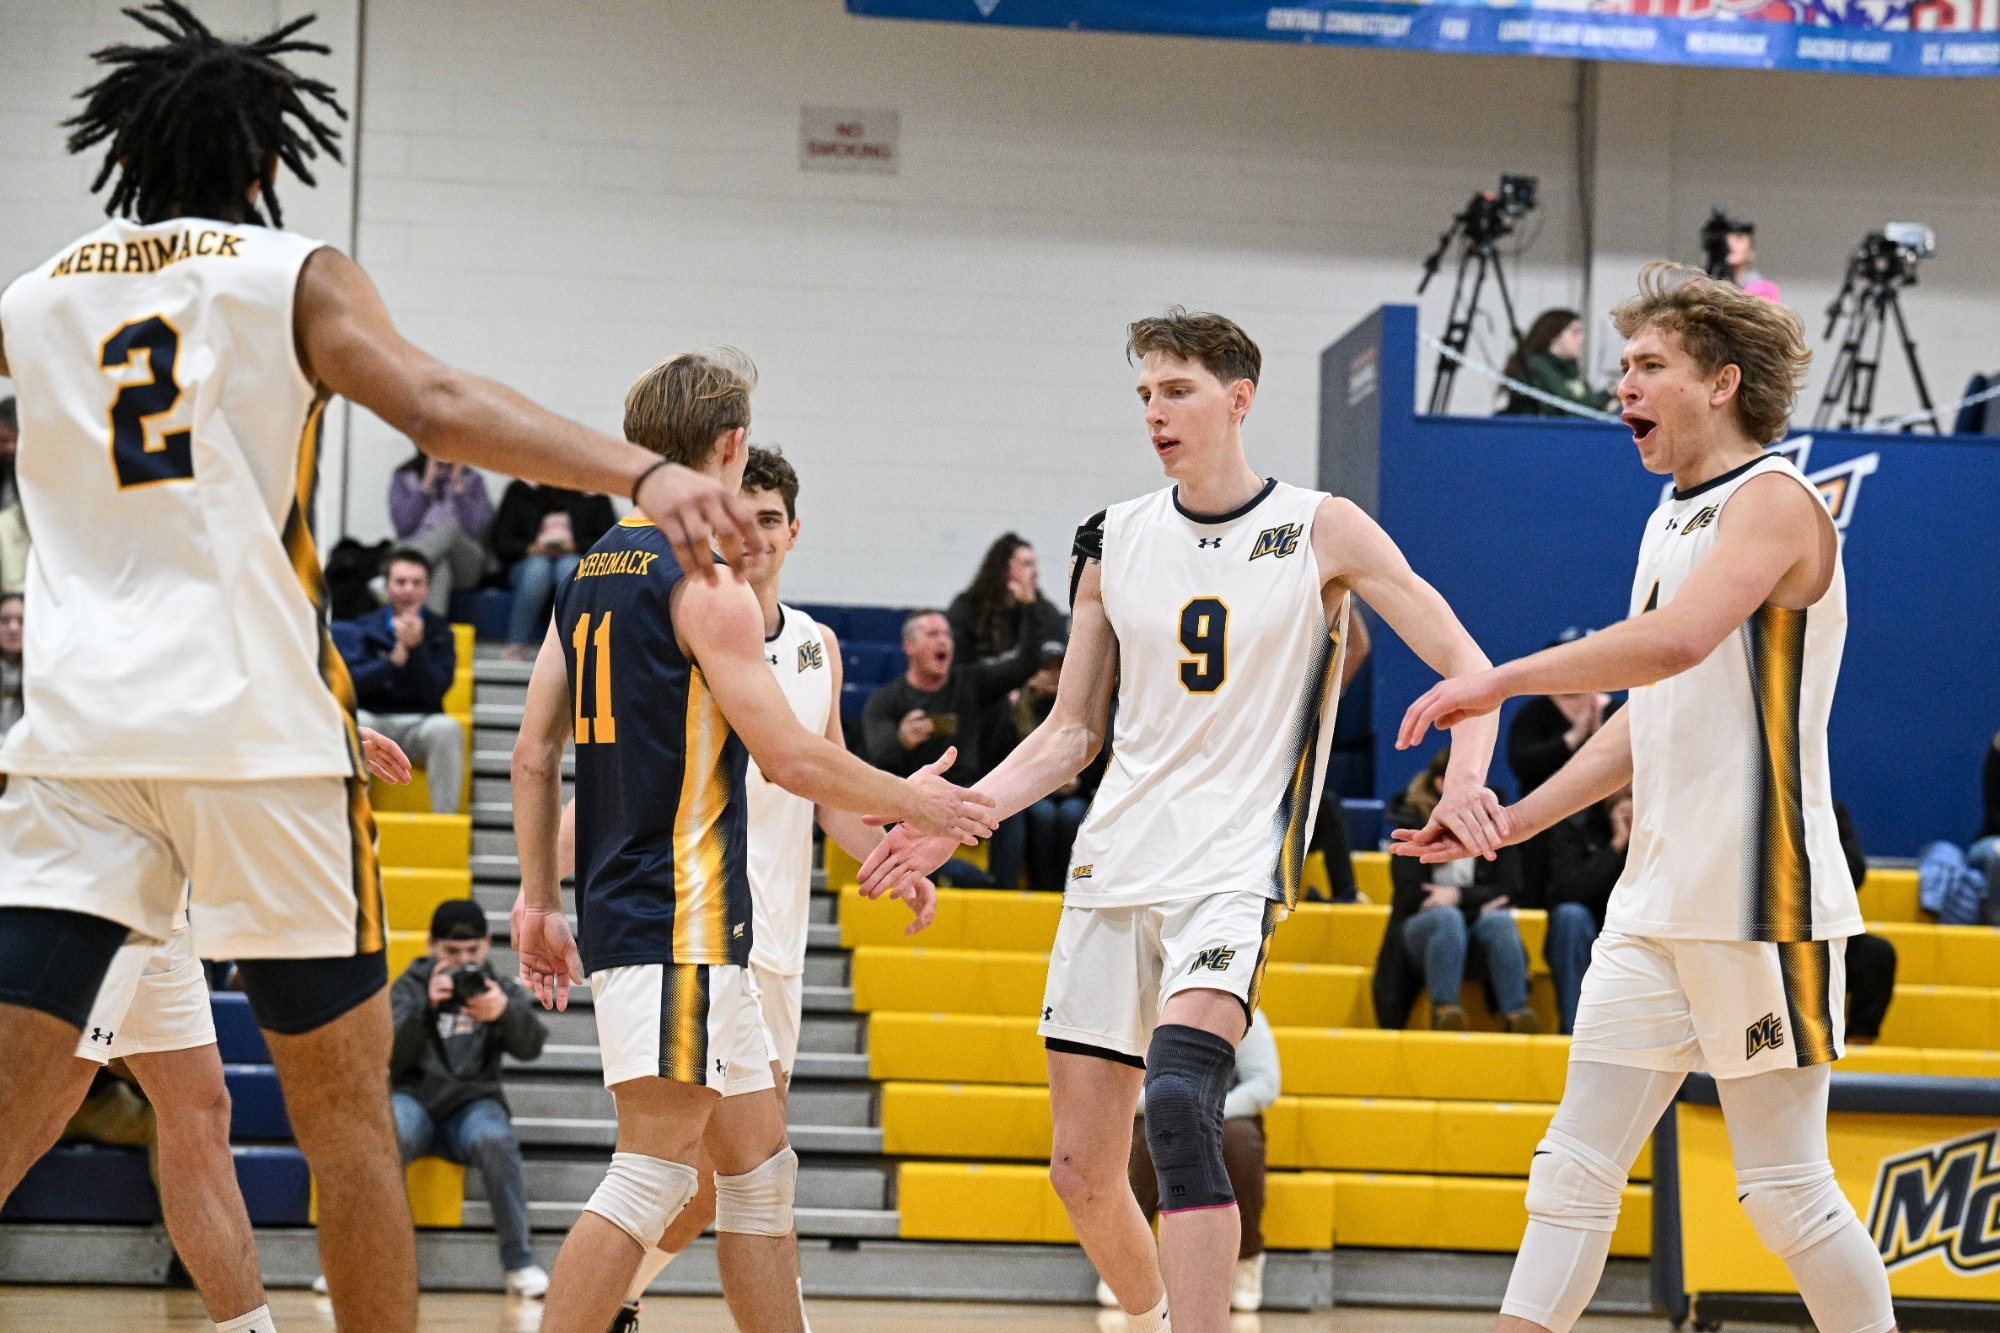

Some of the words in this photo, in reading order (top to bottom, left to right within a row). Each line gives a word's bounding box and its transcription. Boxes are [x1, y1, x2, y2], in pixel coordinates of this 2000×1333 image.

[807, 141, 891, 159] SMOKING
[50, 229, 246, 279] MERRIMACK
[100, 312, 195, 491] 2
[1249, 522, 1304, 562] MC
[798, 640, 823, 673] MC
[1177, 595, 1231, 695] 9
[573, 611, 616, 744] 11
[1746, 1012, 1784, 1061] MC
